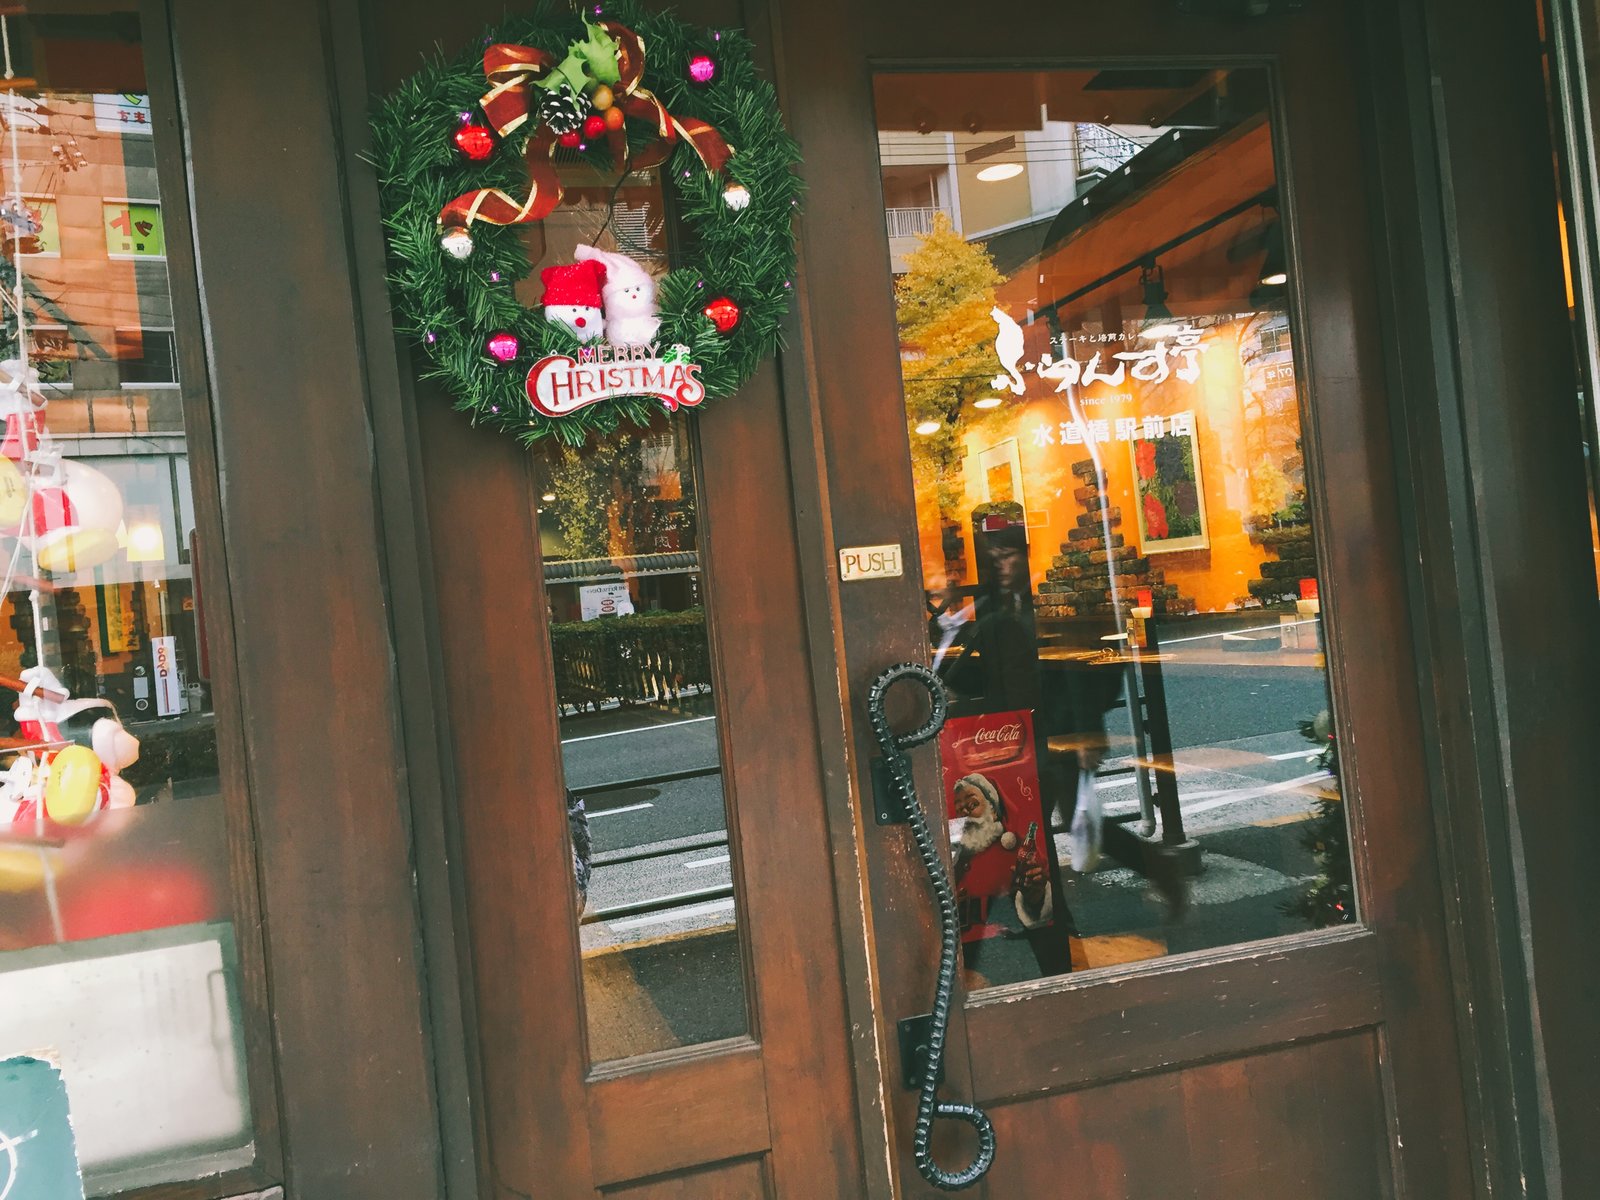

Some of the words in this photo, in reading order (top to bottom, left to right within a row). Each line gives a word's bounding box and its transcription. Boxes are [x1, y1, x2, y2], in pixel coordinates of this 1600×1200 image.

[578, 341, 661, 366] MERRY
[525, 354, 706, 418] CHRISTMAS
[1079, 396, 1107, 406] since
[1031, 413, 1192, 448] 水道橋駅前店
[845, 551, 897, 574] PUSH
[974, 723, 1022, 745] Coca-Cola
